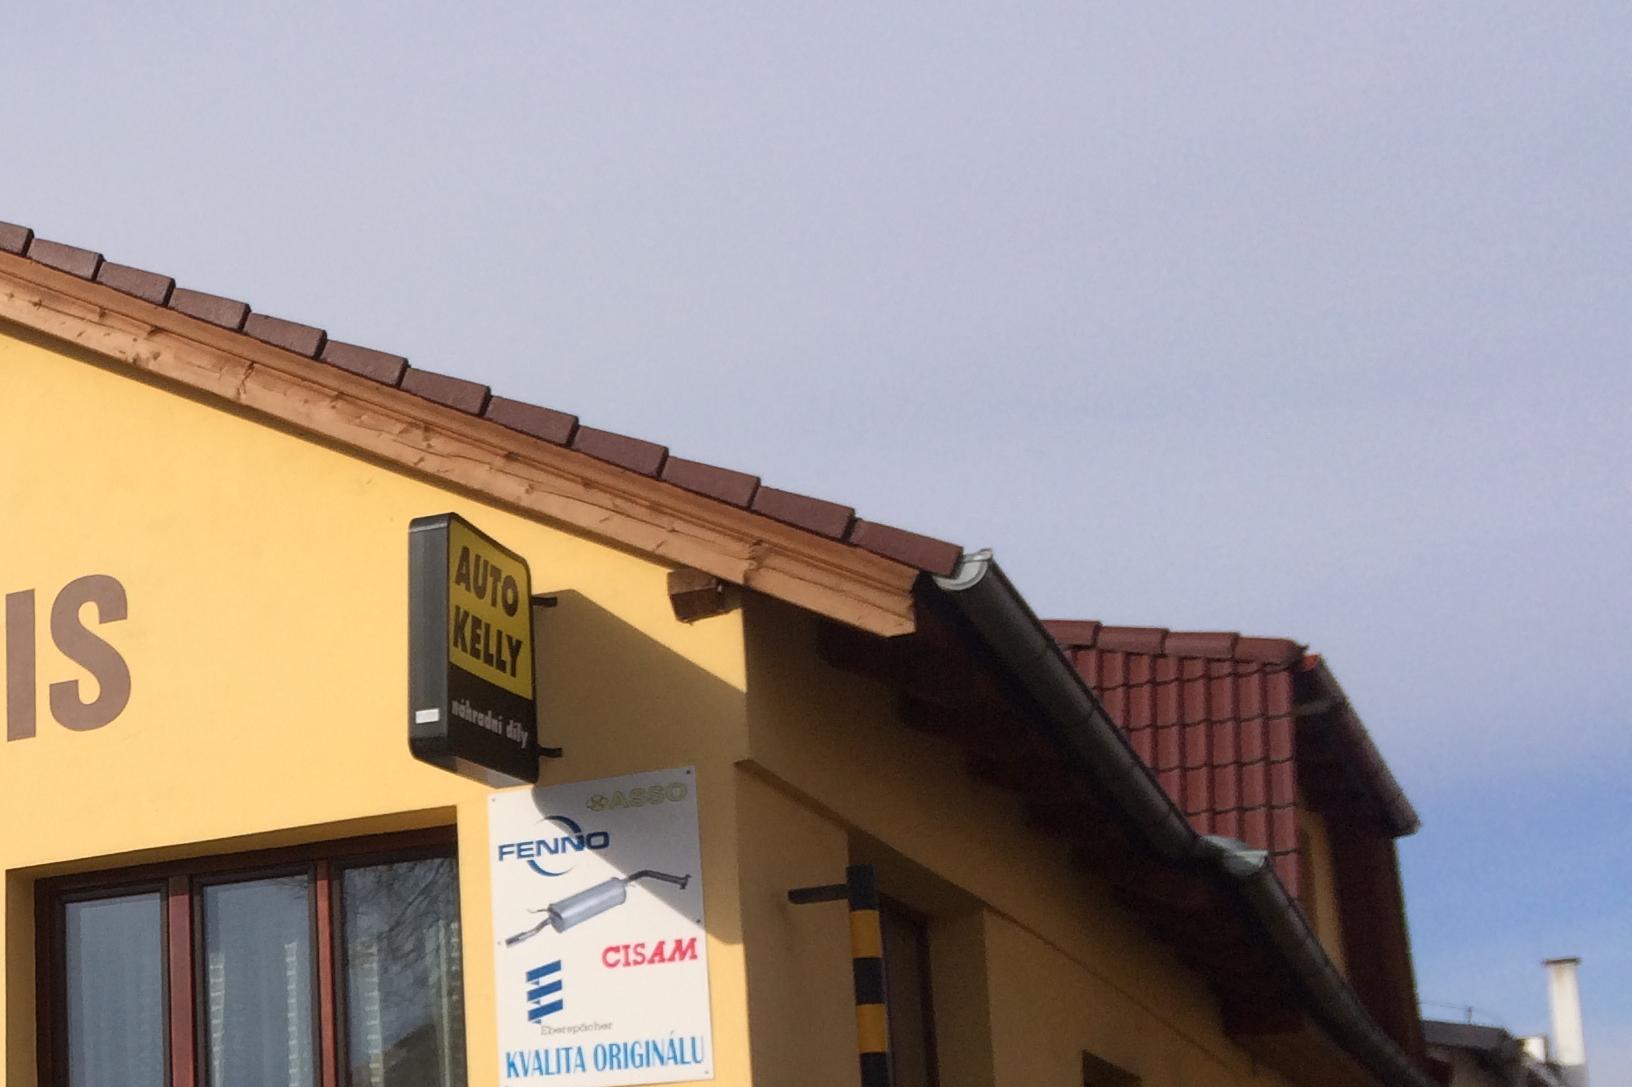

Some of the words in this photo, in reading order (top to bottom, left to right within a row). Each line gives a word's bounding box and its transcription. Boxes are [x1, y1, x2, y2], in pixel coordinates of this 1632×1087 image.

[455, 546, 518, 617] AUTO
[453, 605, 522, 678] KELLY
[498, 831, 610, 861] FENNO
[601, 938, 698, 969] CISAM
[505, 1046, 586, 1079] KVALITA
[593, 1030, 704, 1072] ORIGINÁLU
